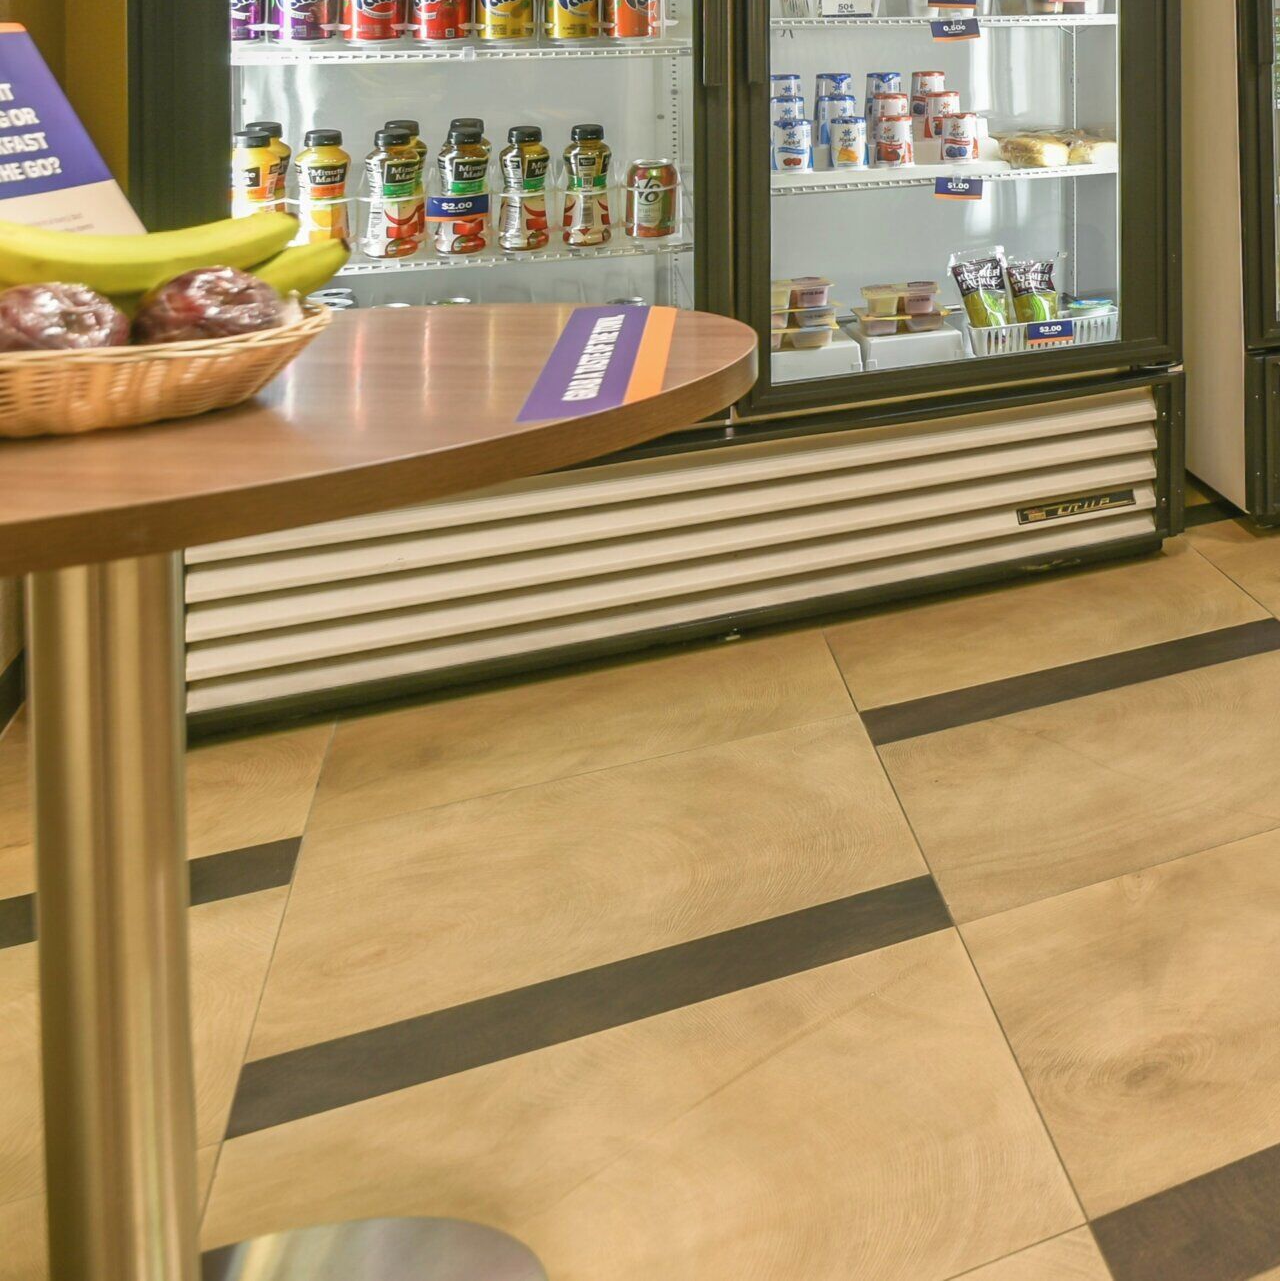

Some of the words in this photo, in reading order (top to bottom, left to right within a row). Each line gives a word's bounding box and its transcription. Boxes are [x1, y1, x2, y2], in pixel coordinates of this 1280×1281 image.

[8, 107, 40, 125] OR
[23, 156, 62, 178] GO?
[315, 174, 341, 183] Maid
[441, 202, 473, 210] $2.00
